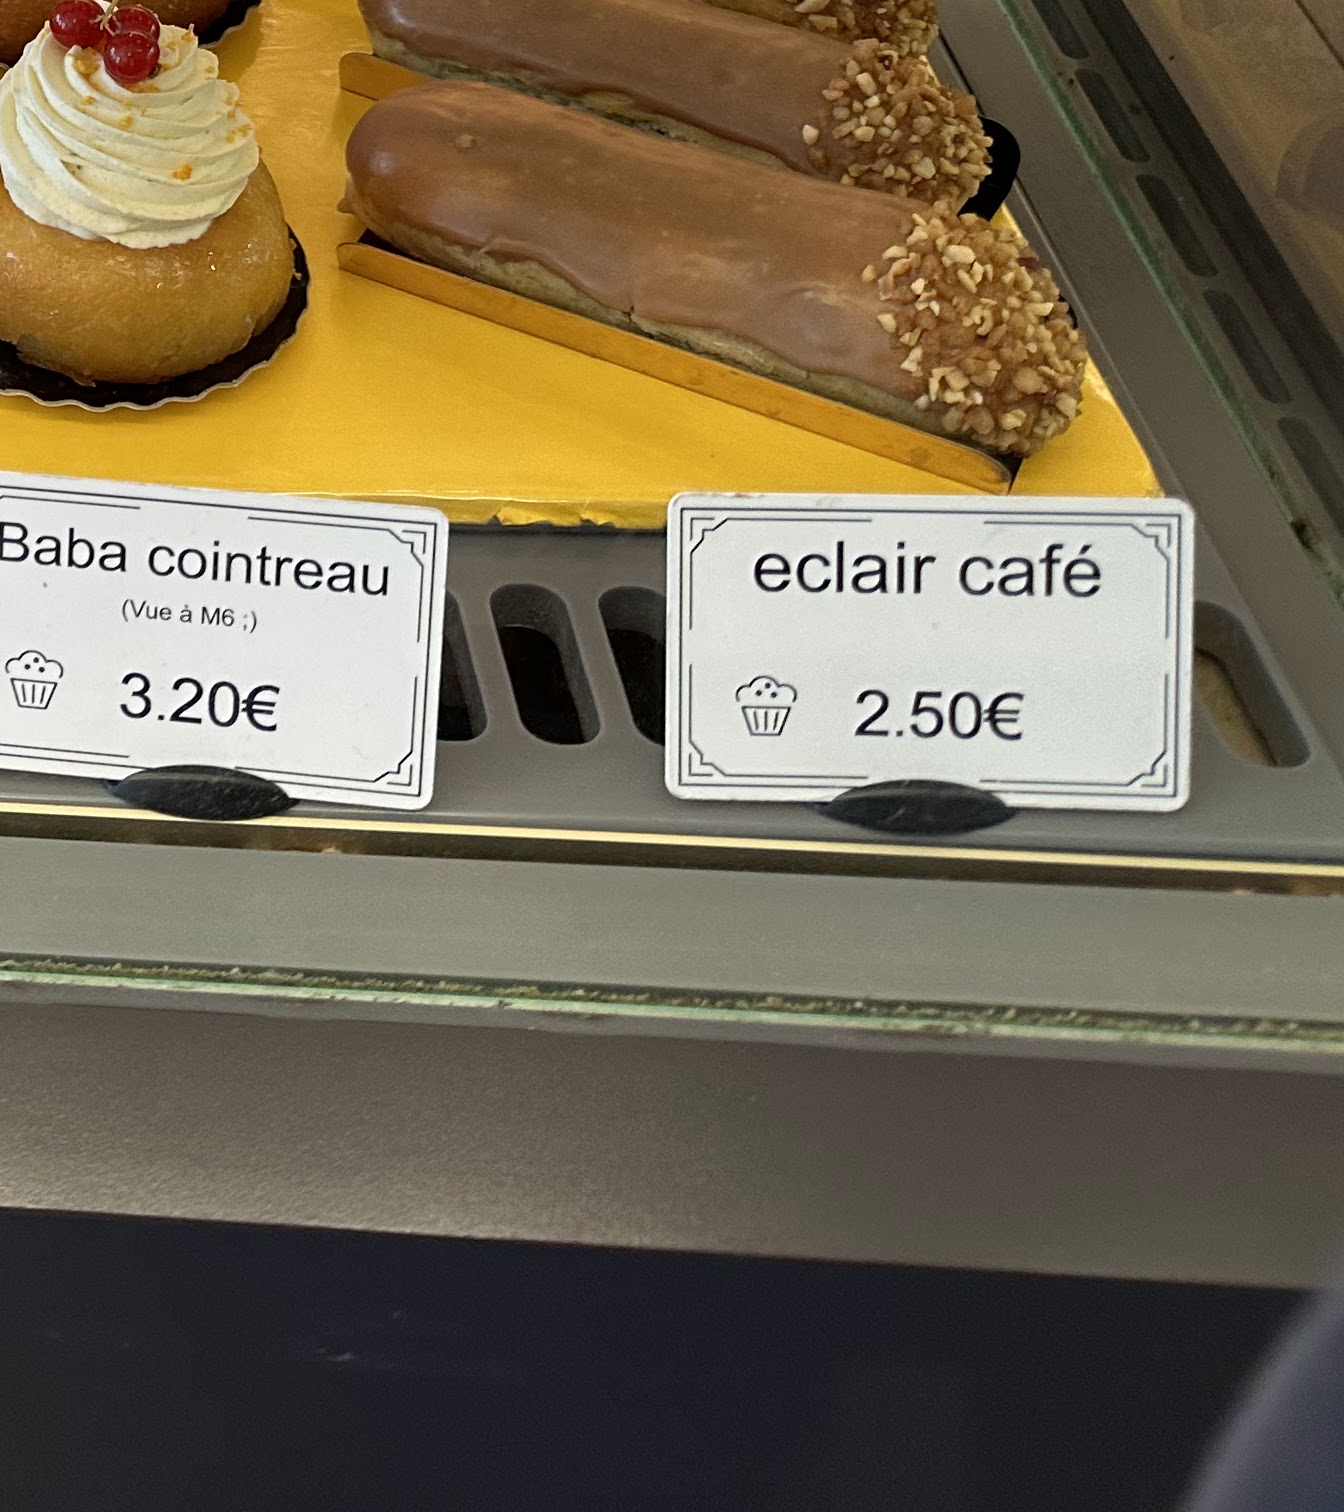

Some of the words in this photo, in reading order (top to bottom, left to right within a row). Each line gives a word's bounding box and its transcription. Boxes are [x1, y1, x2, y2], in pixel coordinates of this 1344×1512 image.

[147, 541, 390, 596] cointreau
[753, 540, 936, 593] eclair
[957, 543, 1102, 598] café
[122, 599, 172, 622] (Vue
[179, 604, 193, 623] à
[200, 606, 235, 627] M6
[119, 672, 281, 732] 3.20€
[854, 689, 1025, 741] 2.50€
